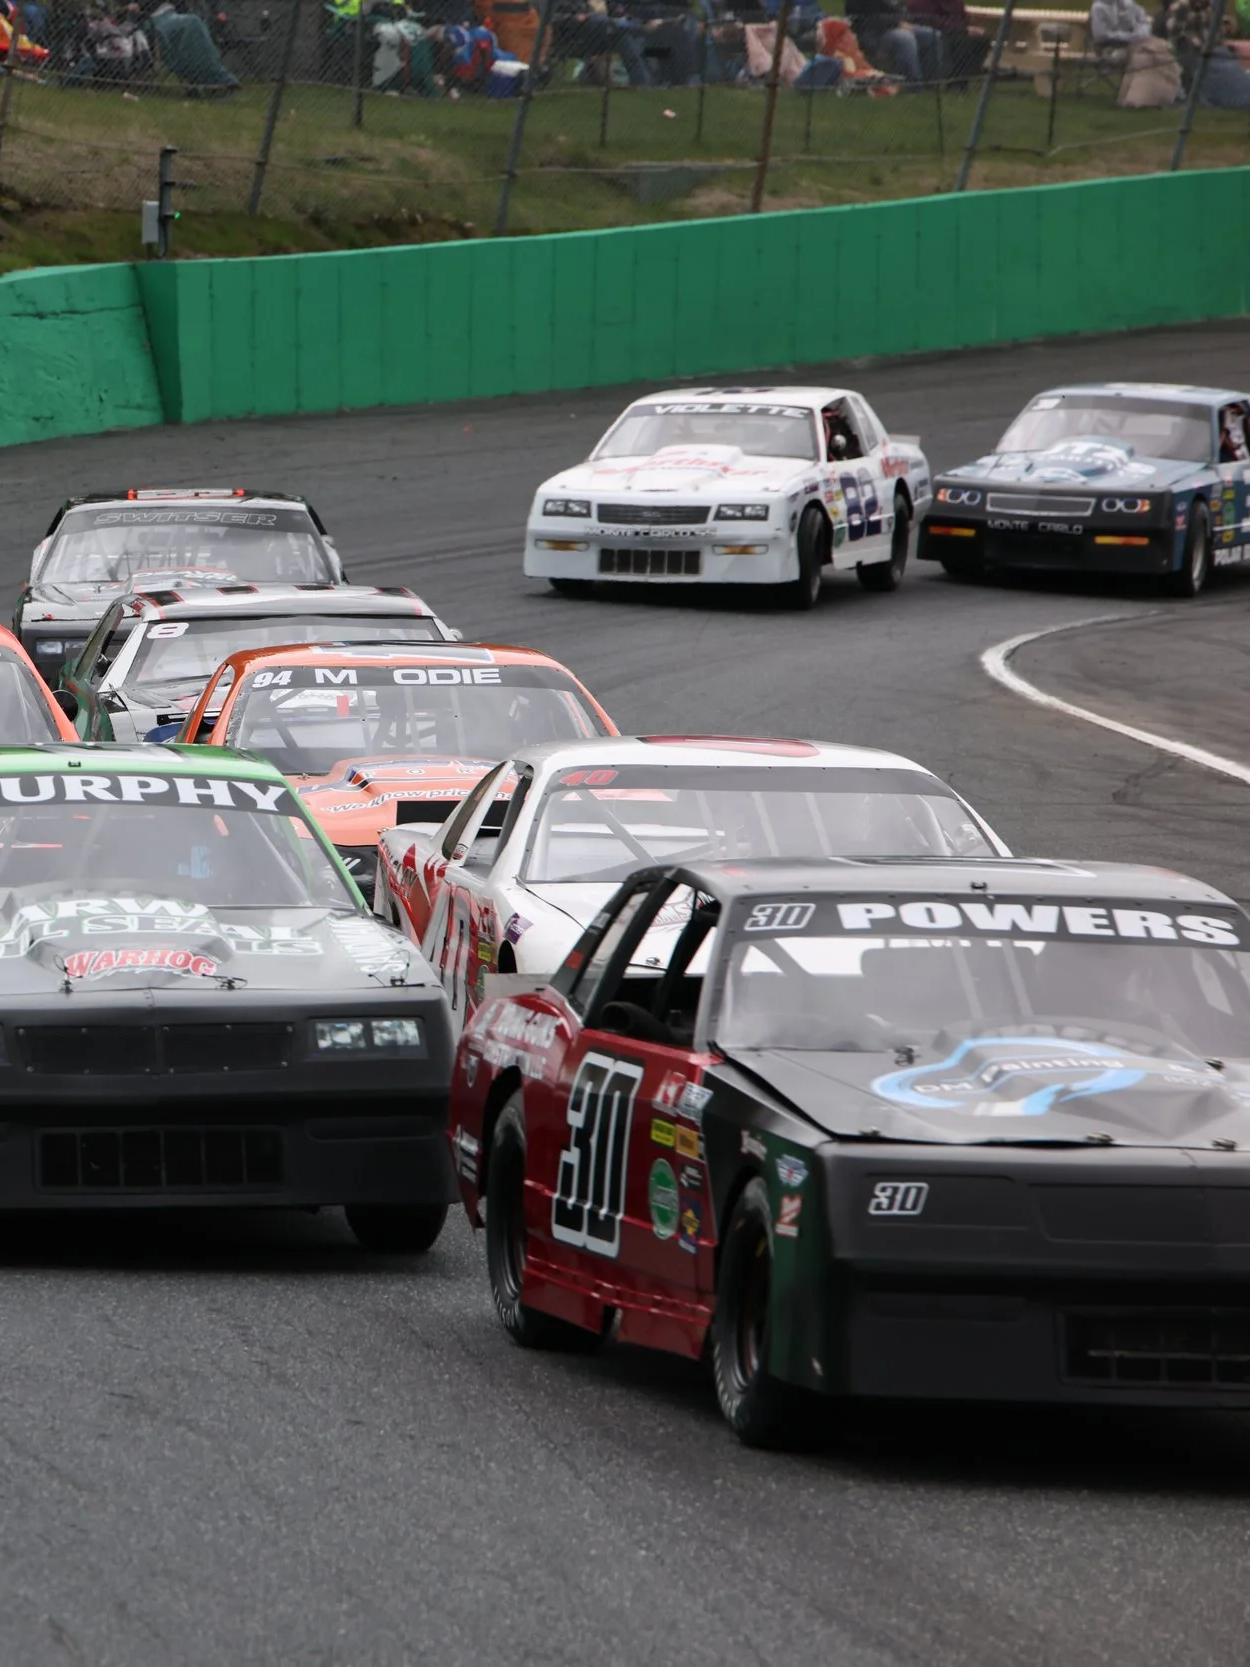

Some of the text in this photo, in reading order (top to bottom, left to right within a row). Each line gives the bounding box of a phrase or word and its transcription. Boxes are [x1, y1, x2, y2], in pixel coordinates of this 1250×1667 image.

[654, 402, 810, 418] VIOLETTE
[94, 511, 278, 526] SWITSER
[987, 518, 1083, 536] MONTE CARLO
[147, 622, 190, 639] 8
[252, 670, 293, 688] 94
[393, 668, 502, 685] ODIE
[559, 769, 619, 786] 40
[367, 788, 423, 809] know
[743, 902, 1240, 946] 30 POWERS
[64, 949, 217, 977] WARHOG
[913, 1080, 973, 1094] DM
[552, 1050, 644, 1259] 30
[867, 1182, 929, 1215] 30
